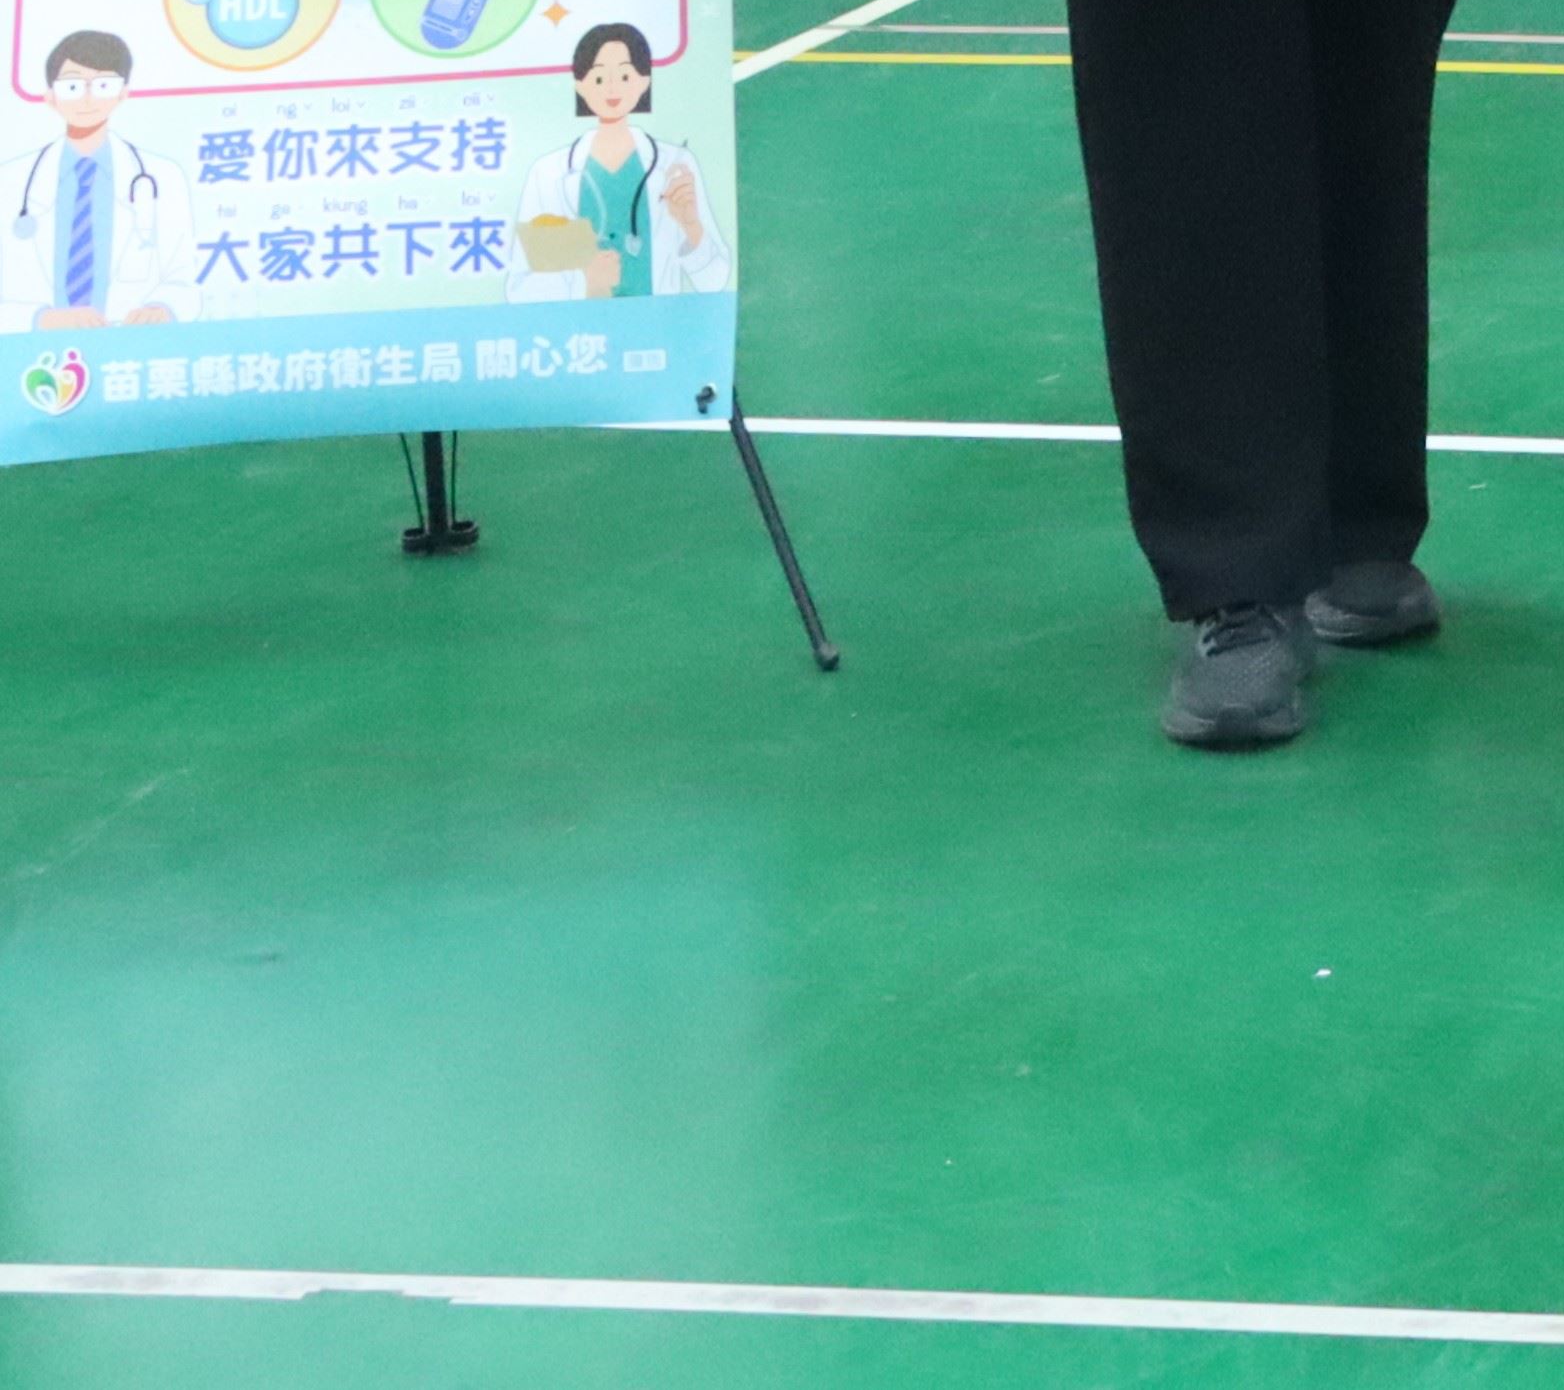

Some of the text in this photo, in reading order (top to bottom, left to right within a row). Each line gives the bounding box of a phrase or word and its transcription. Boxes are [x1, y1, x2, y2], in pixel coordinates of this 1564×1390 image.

[198, 117, 507, 185] 愛你來支持
[196, 216, 507, 285] 大家共下來
[102, 334, 608, 404] 苗栗縣政府衛生局 關心您
